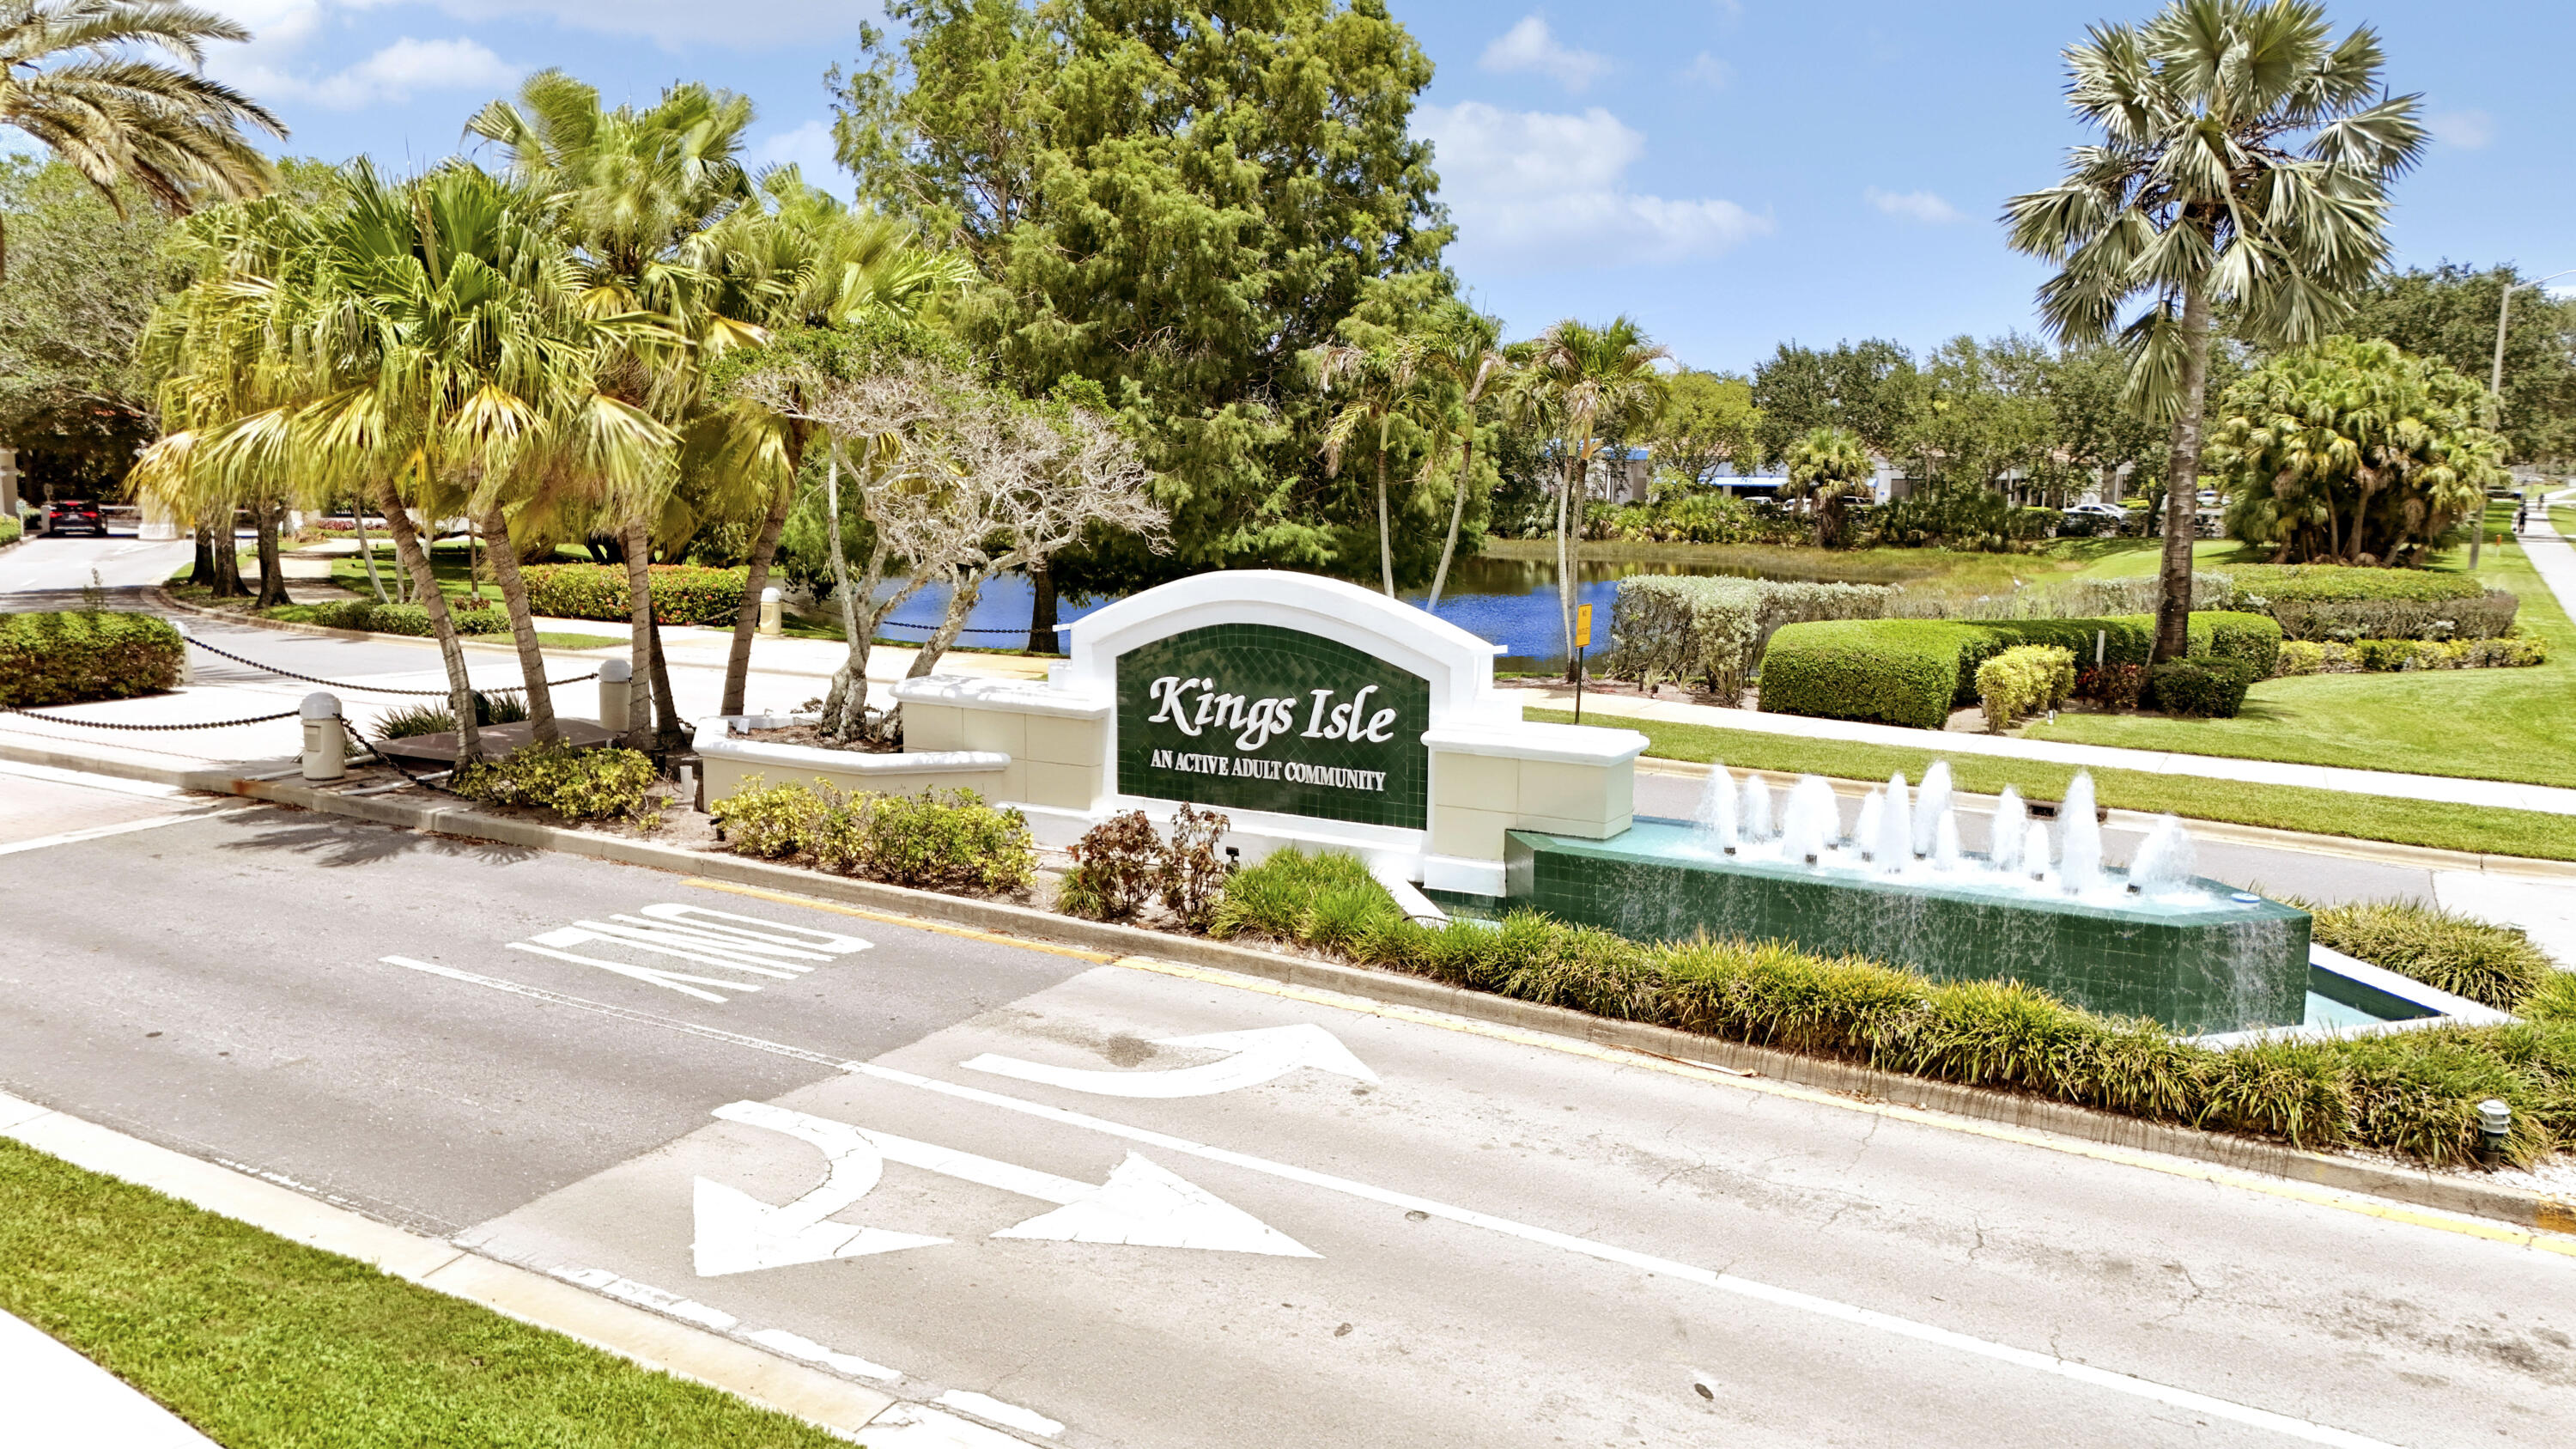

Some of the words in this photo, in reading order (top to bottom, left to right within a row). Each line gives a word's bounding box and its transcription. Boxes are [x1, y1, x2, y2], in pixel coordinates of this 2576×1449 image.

[1148, 677, 1297, 751] Kings
[1300, 685, 1397, 743] Isle
[1151, 749, 1174, 769] AN
[1175, 752, 1229, 776] ACTIVE
[1231, 758, 1282, 780] ADULT
[1284, 762, 1386, 791] COMMUNITY
[505, 903, 875, 1003] ONLY
